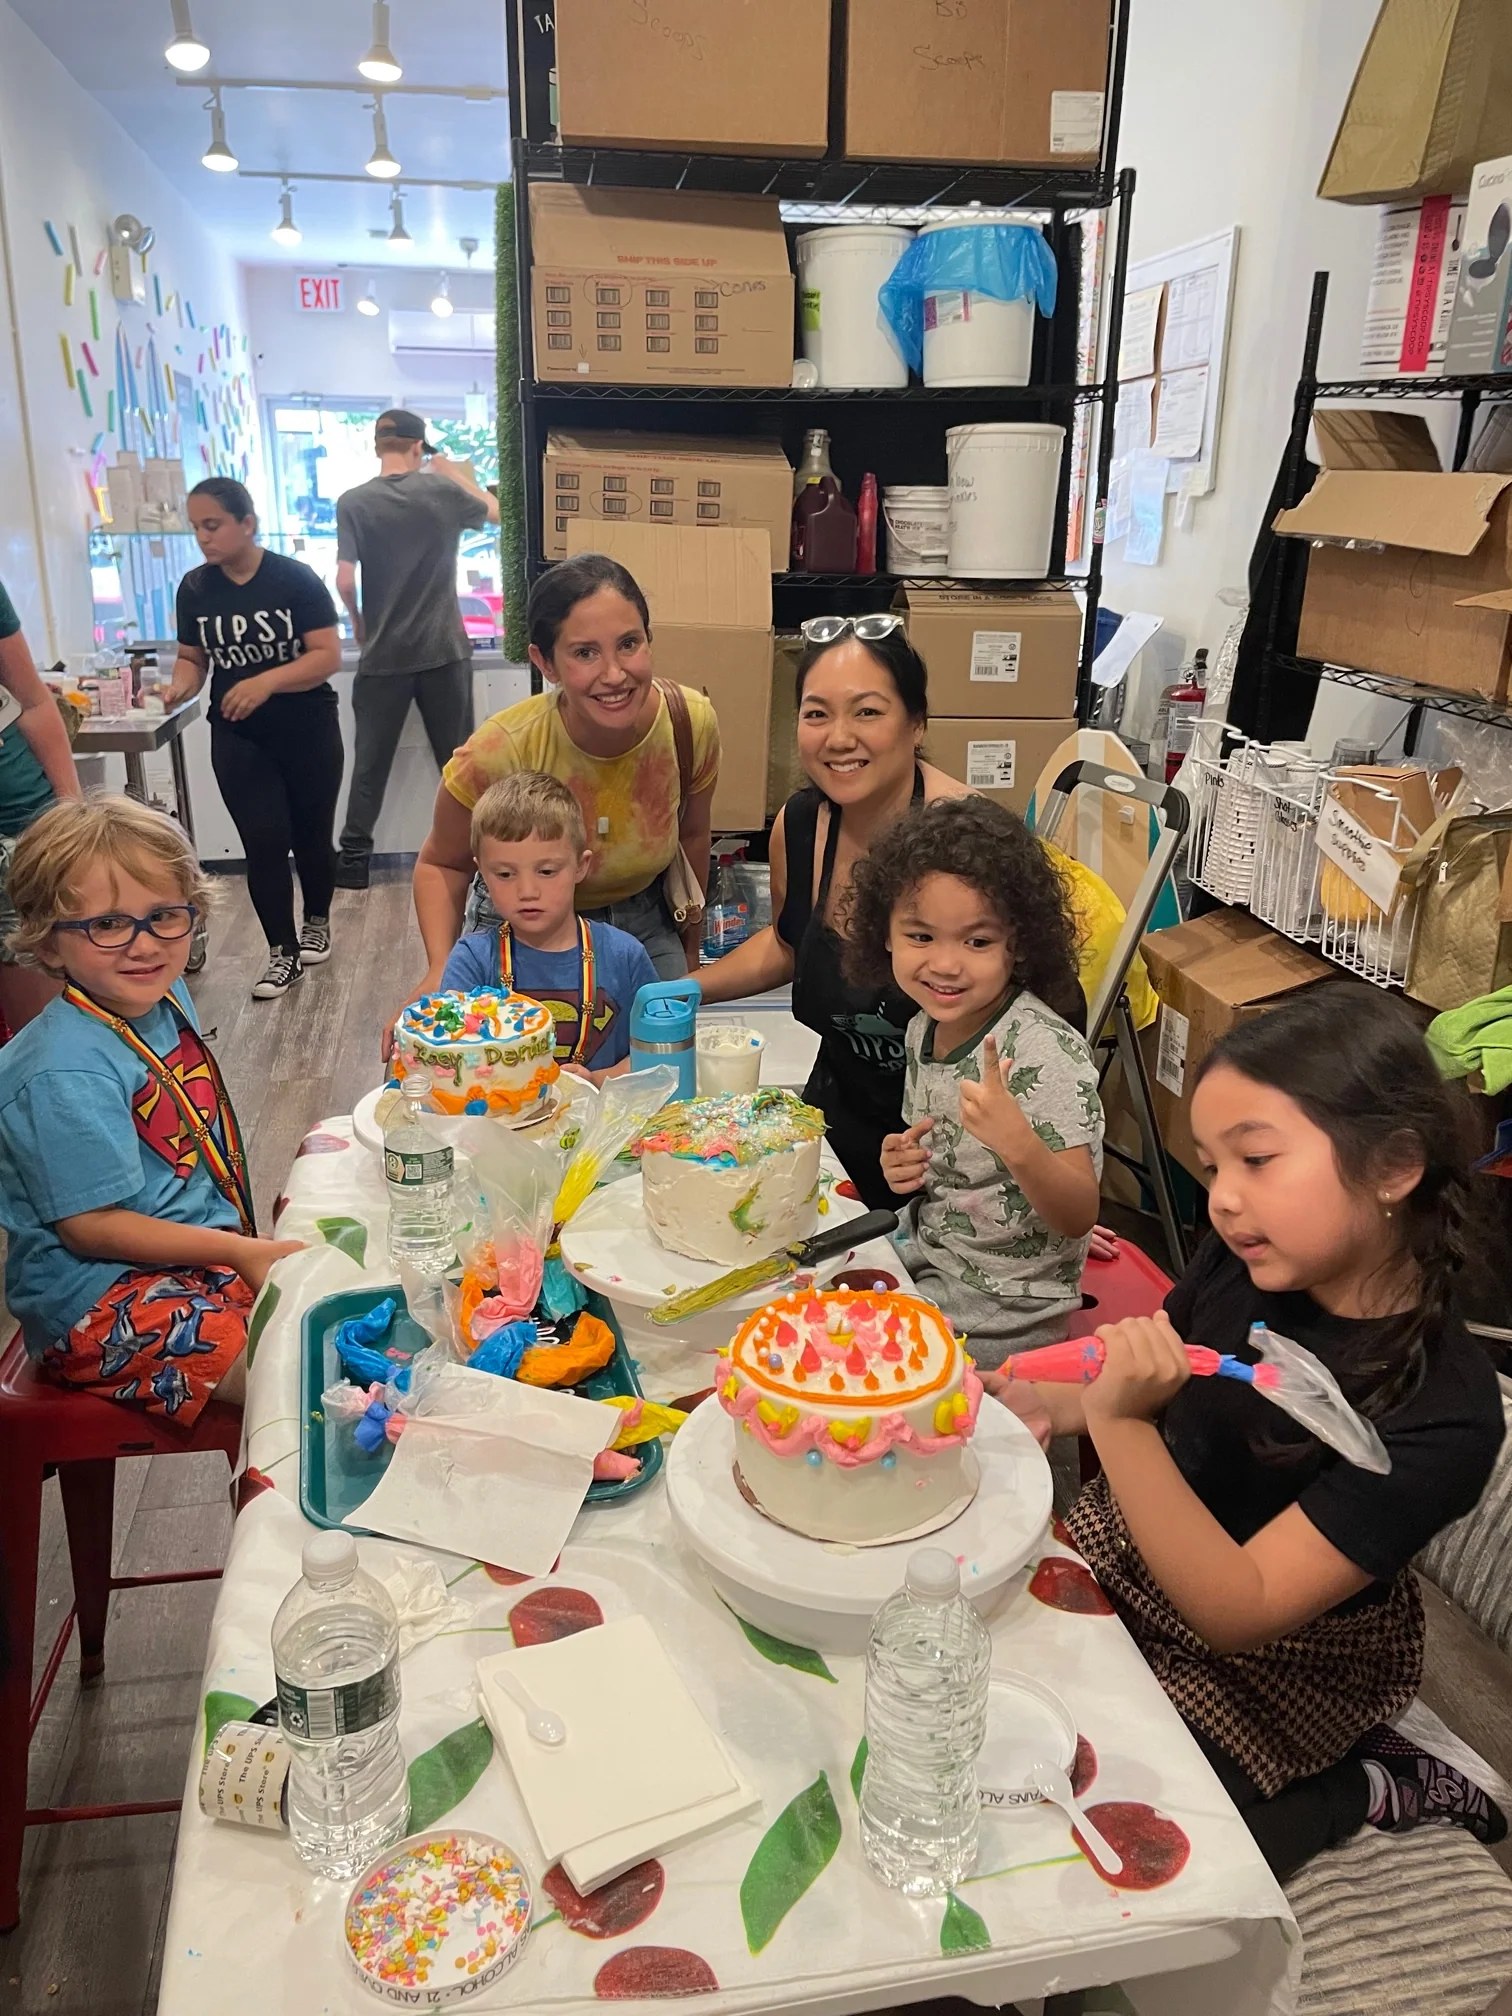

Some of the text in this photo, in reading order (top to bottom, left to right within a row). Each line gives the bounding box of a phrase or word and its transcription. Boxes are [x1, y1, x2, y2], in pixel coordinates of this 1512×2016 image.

[299, 278, 340, 309] EXIT
[196, 608, 294, 648] TIPSY
[207, 639, 301, 669] COOPER
[1205, 772, 1225, 788] Pints
[1273, 796, 1297, 813] Shot
[713, 918, 746, 936] Windex
[831, 1025, 905, 1060] TIPS
[218, 1762, 230, 1786] Store
[238, 1747, 258, 1783] The UPS
[255, 1796, 264, 1812] UPS
[452, 1949, 518, 1997] ALCOHOL
[386, 1988, 421, 2004] AND
[426, 1991, 441, 2004] 21
